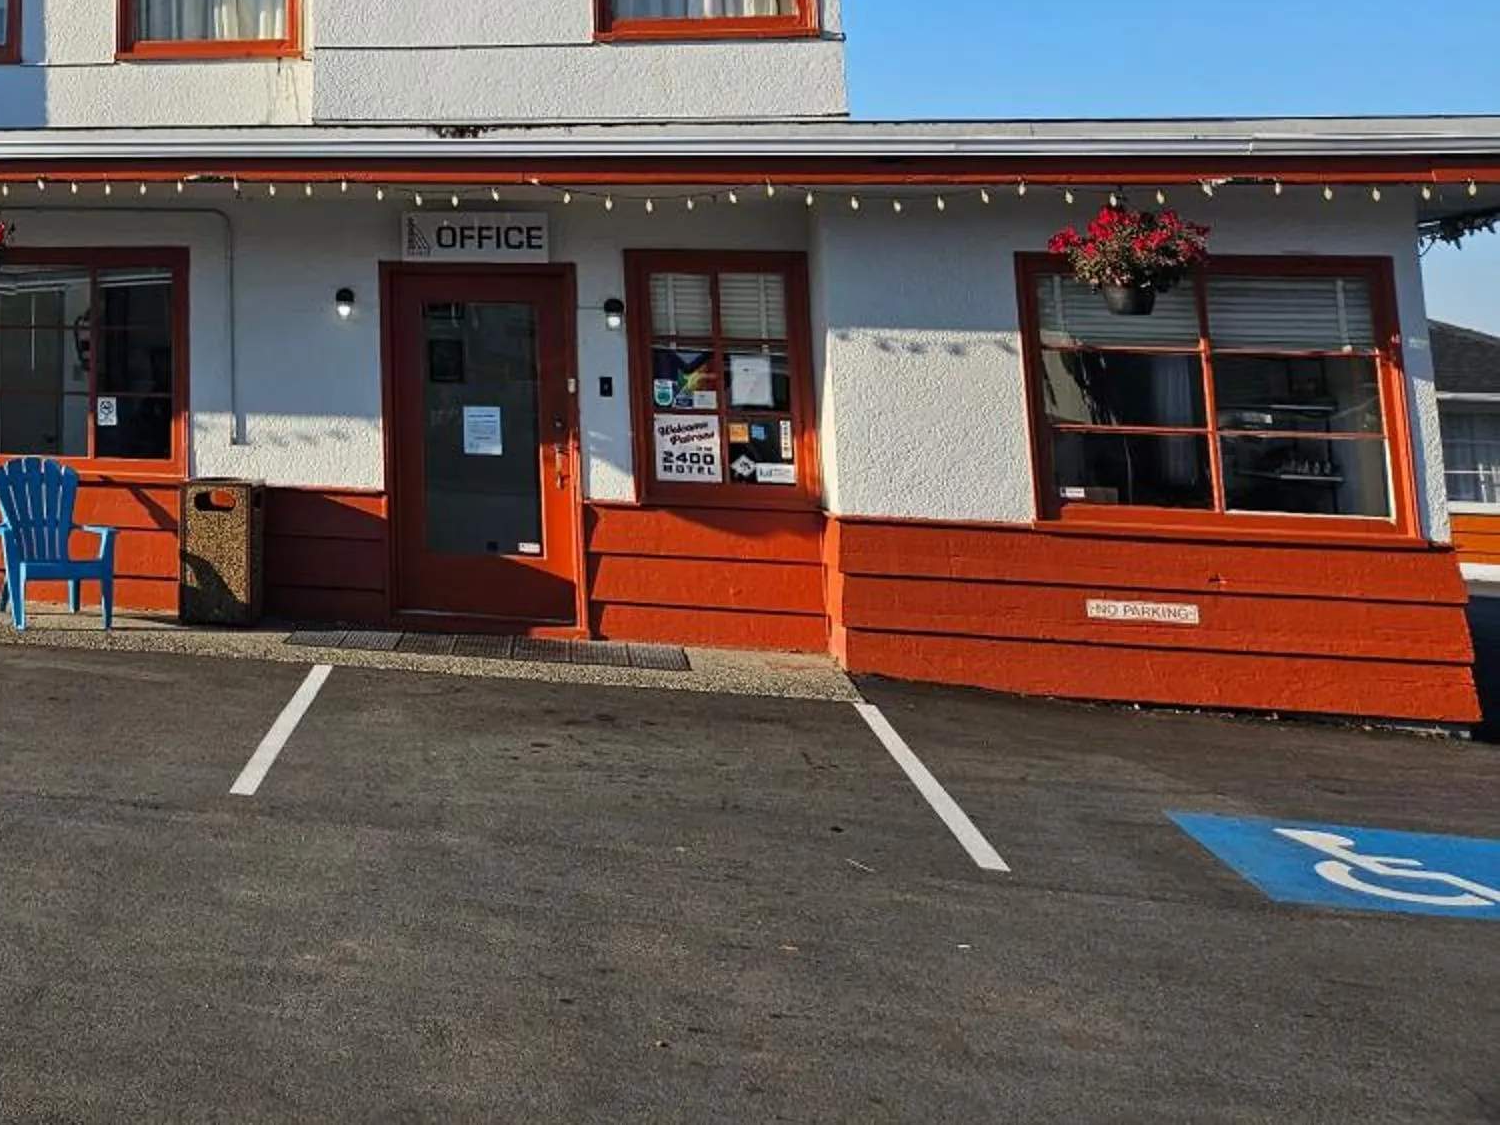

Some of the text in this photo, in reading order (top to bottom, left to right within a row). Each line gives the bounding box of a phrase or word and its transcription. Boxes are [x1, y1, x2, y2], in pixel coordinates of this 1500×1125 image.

[436, 226, 544, 250] OFFICE
[663, 451, 715, 465] 2400
[663, 465, 716, 476] MOTEL
[1095, 604, 1188, 619] NO PARKING
